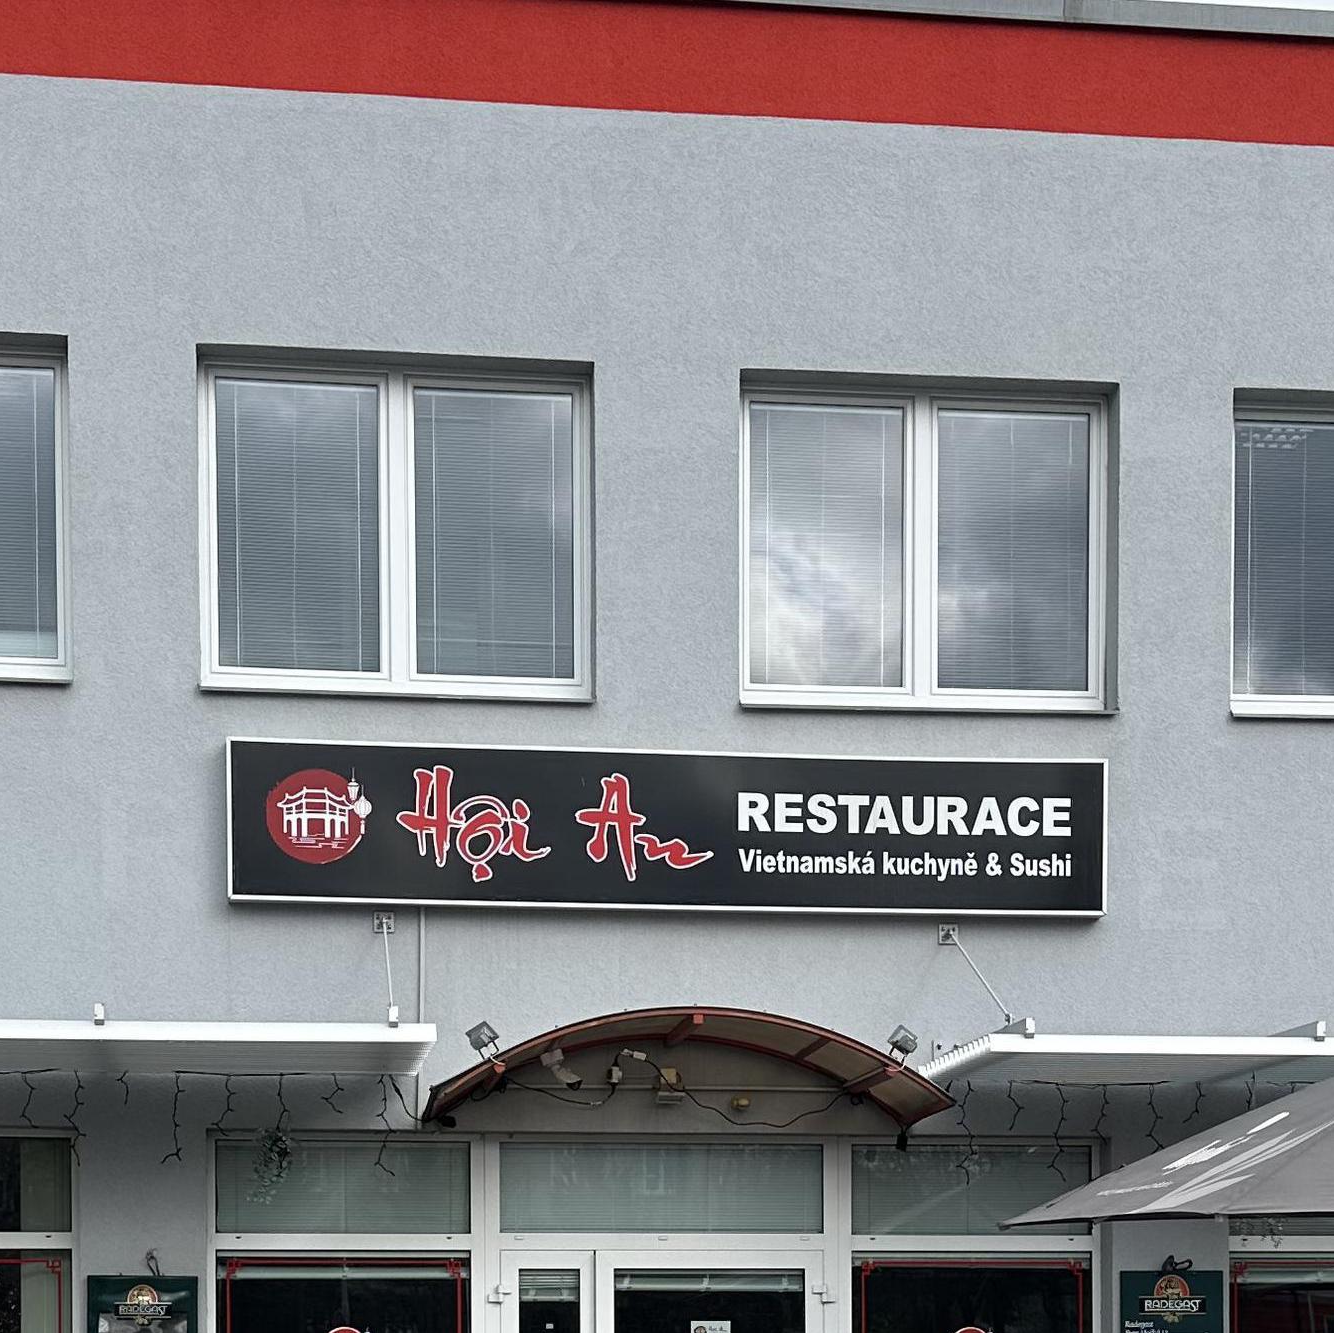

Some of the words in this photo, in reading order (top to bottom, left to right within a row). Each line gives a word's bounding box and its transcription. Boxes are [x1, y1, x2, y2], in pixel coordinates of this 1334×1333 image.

[576, 773, 714, 881] An
[737, 792, 1072, 837] RESTAURACE
[738, 848, 875, 876] Vietnamská
[882, 850, 978, 882] kuchyně
[985, 855, 1003, 876] &
[1009, 852, 1072, 877] Sushi
[1144, 1300, 1203, 1312] RADEGAST
